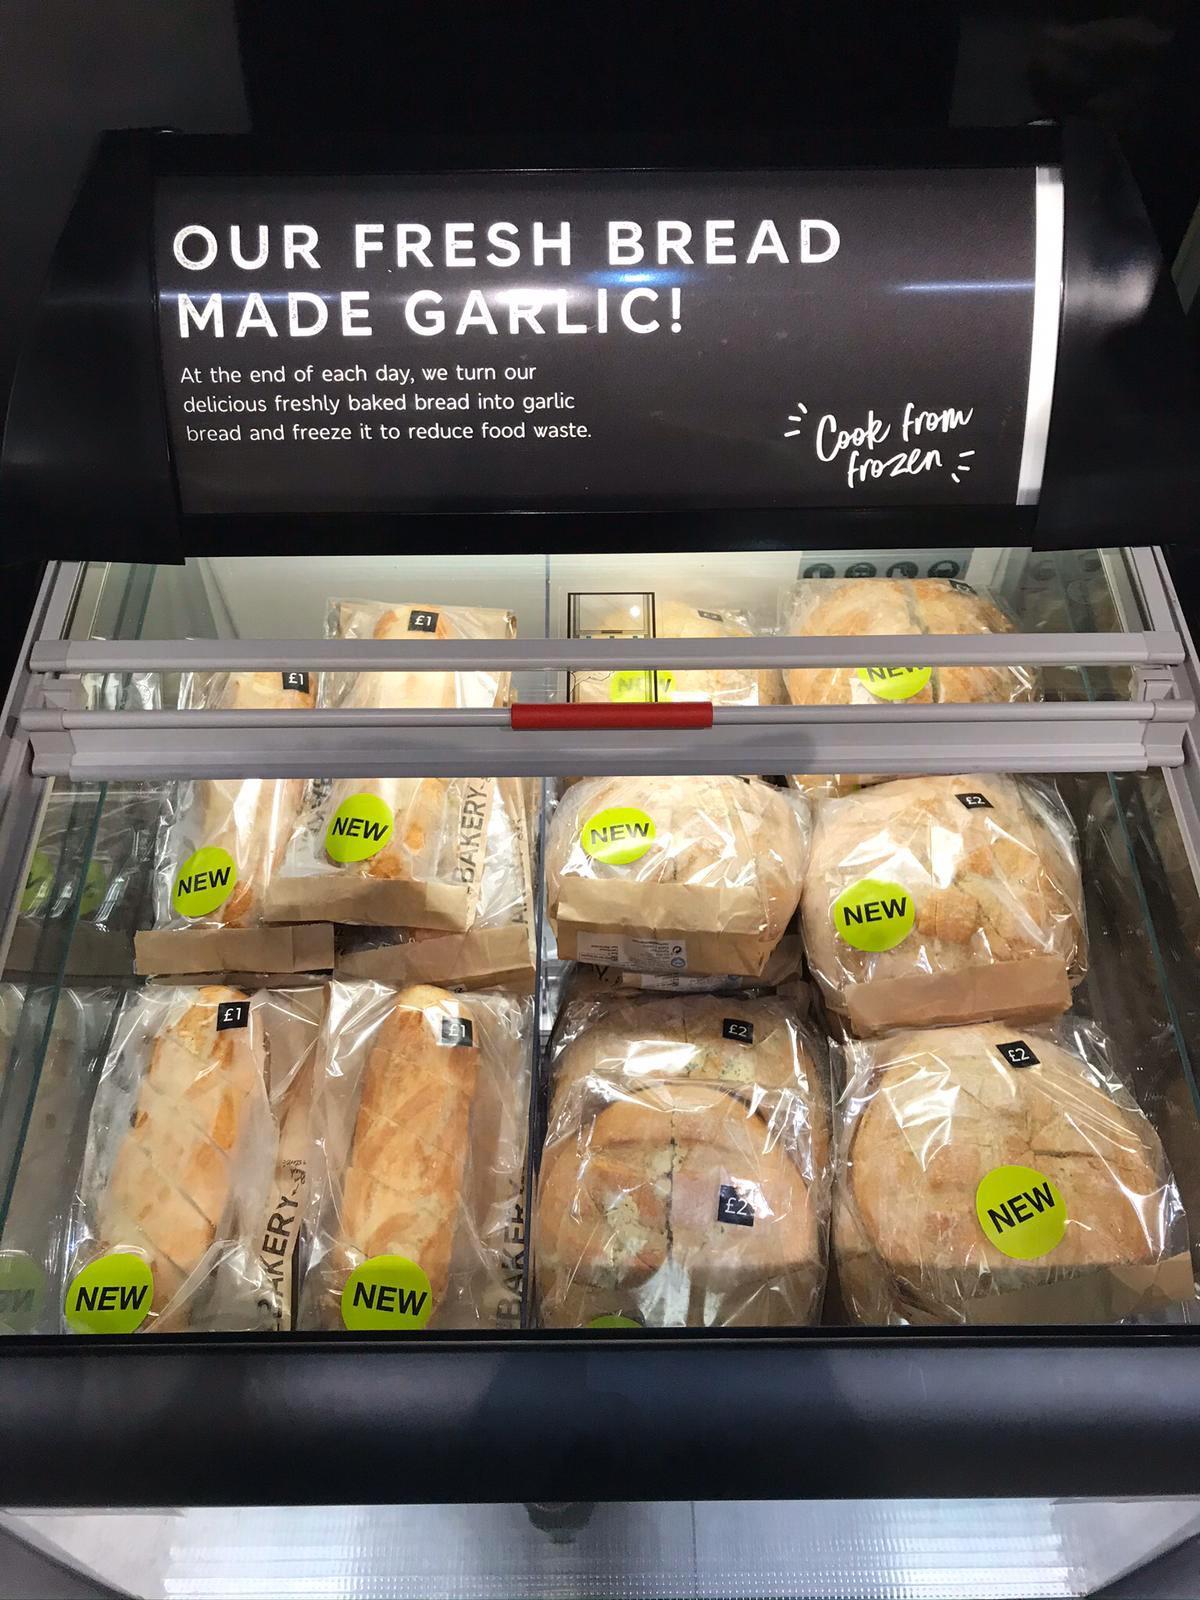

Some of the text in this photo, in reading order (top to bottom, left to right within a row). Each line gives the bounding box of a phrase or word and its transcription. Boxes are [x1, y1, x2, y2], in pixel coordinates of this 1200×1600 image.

[173, 219, 840, 270] OUR FRESH BREAD
[176, 286, 681, 338] MADE GARLIC!
[181, 365, 536, 385] At the end of each day, we turn our
[184, 392, 574, 415] delicious freshly baked bread into garlic
[187, 422, 591, 441] bread and freeze it to reduce food waste.
[815, 403, 973, 462] Cook from
[845, 445, 942, 488] frozen
[414, 614, 432, 627] £1
[288, 672, 304, 685] £1
[966, 796, 984, 806] £2
[332, 817, 389, 841] NEW
[590, 822, 650, 848] NEW
[177, 867, 232, 896] NEW
[843, 897, 907, 926] NEW
[223, 1007, 242, 1023] £1
[448, 1022, 466, 1039] £1
[728, 1024, 747, 1037] £2
[1008, 1047, 1029, 1062] £2
[726, 1197, 748, 1215] £2
[989, 1182, 1054, 1234] NEW
[75, 1285, 148, 1312] NEW
[353, 1283, 428, 1317] NEW
